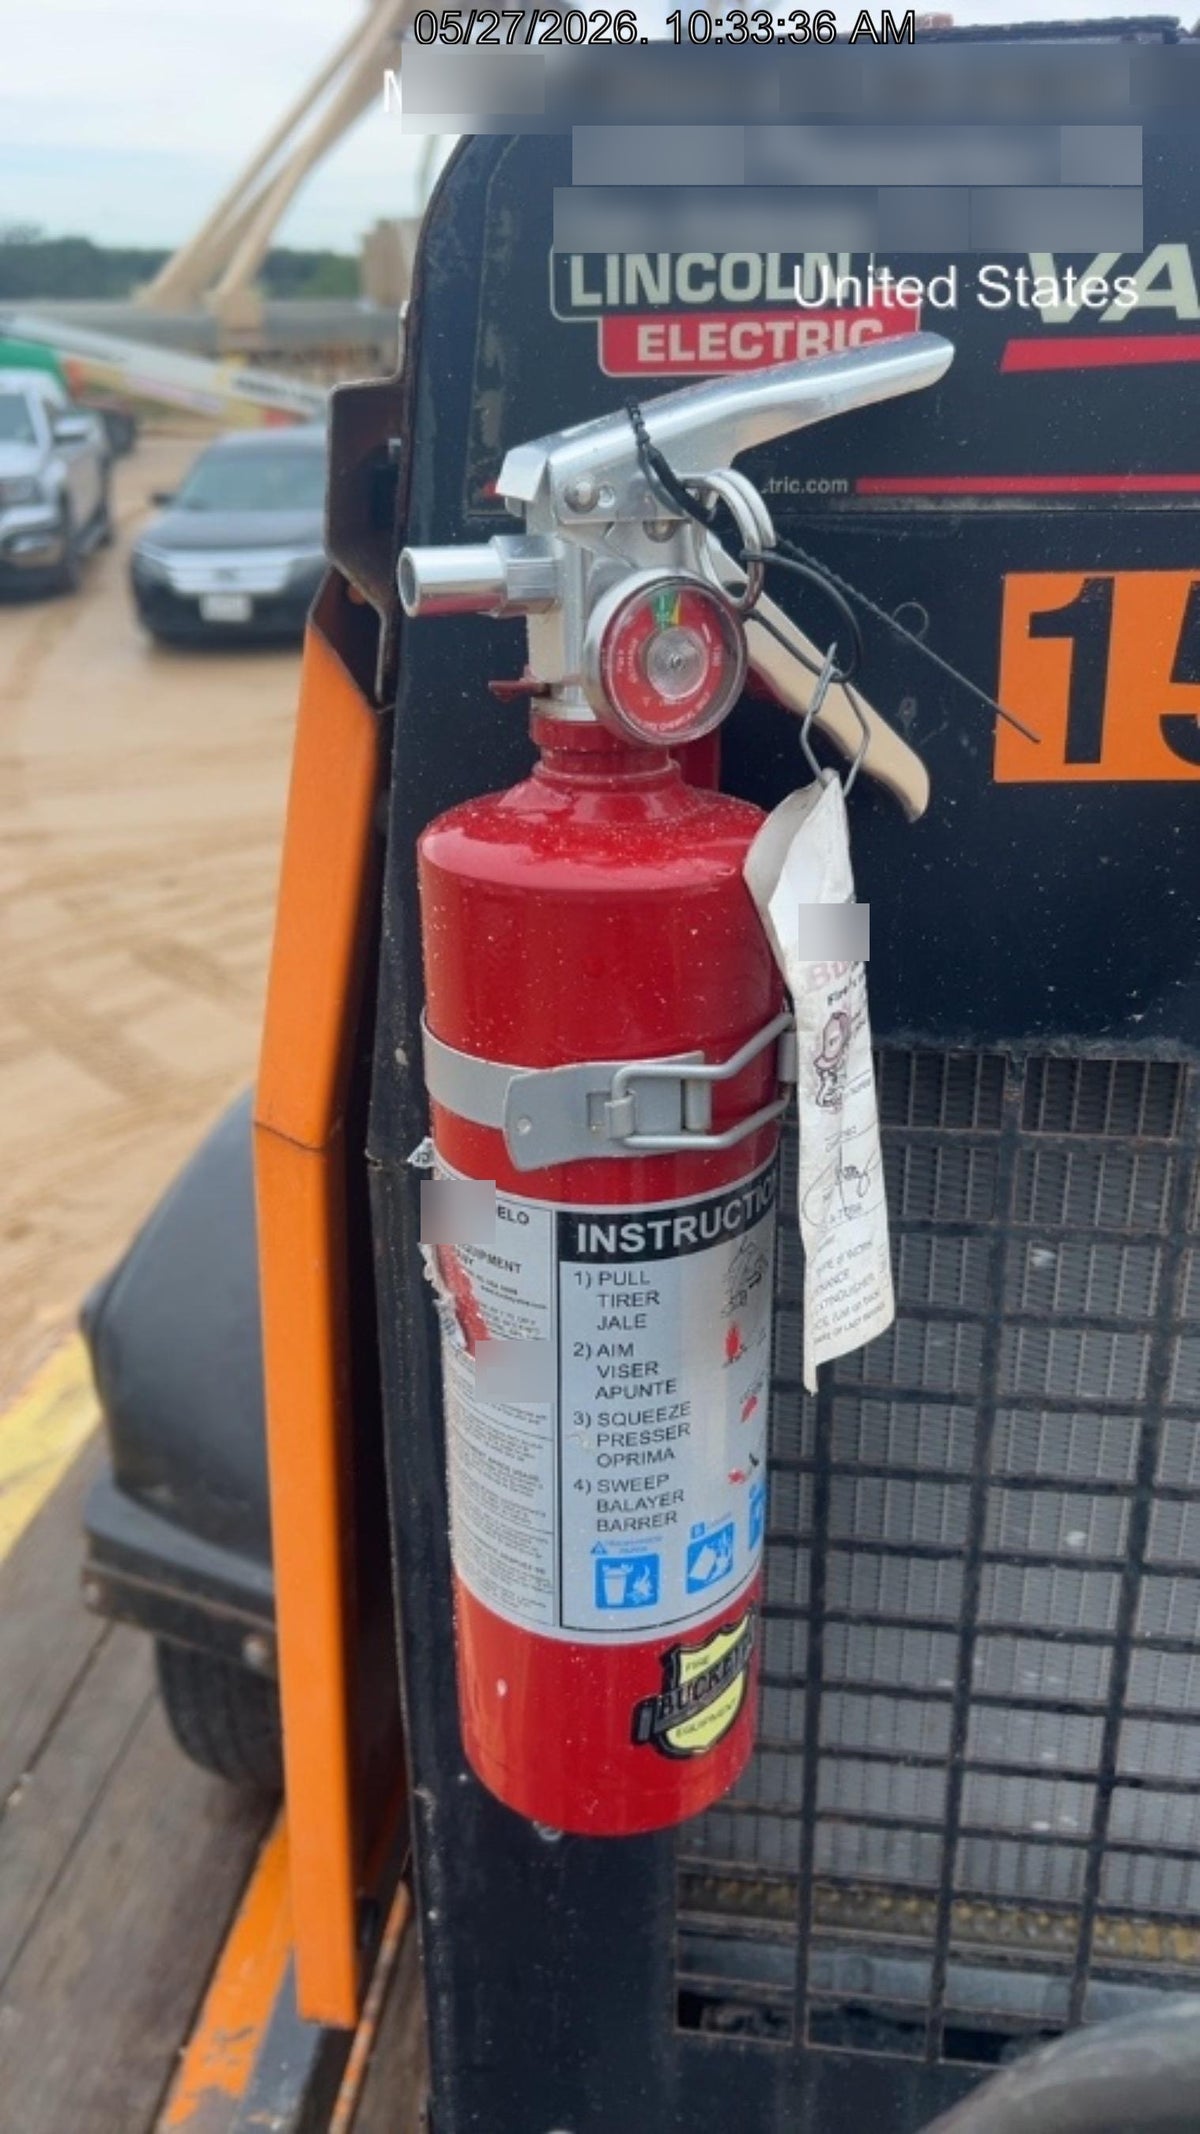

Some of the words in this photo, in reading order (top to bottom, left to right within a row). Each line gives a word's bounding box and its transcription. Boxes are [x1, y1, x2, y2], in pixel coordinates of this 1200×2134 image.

[570, 251, 851, 306] LINCOLN
[761, 476, 849, 494] tric.com
[497, 1205, 530, 1226] ELO
[577, 1174, 775, 1254] INSTRUCTIO
[573, 1270, 592, 1290] 1)
[597, 1270, 651, 1287] PULL
[597, 1288, 661, 1309] TIRER
[596, 1312, 648, 1331] JALE
[573, 1341, 592, 1361] 2)
[596, 1342, 635, 1358] AIM
[596, 1360, 659, 1379] VISER
[594, 1377, 678, 1400] APUNTE
[573, 1410, 592, 1429] 3)
[597, 1400, 691, 1427] SQUEEZE
[596, 1421, 691, 1448] PRESSER
[596, 1447, 676, 1469] OPRIMA
[573, 1478, 592, 1496] 4)
[597, 1472, 670, 1494] SWEEP
[596, 1488, 685, 1514] BALAYER
[596, 1510, 678, 1533] BARRER
